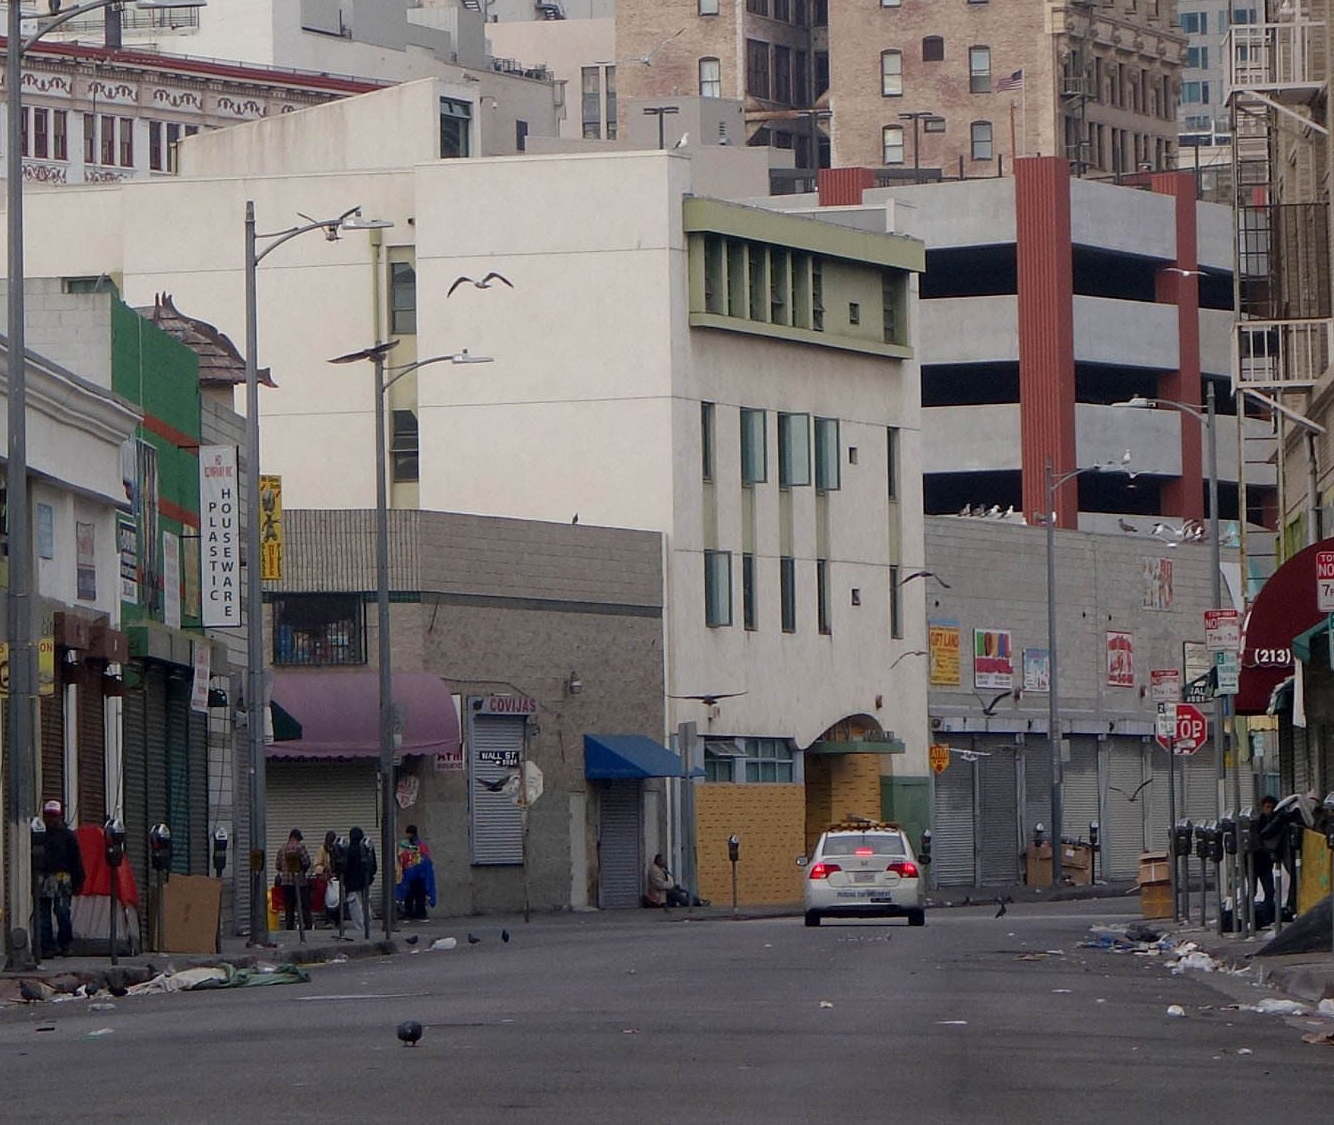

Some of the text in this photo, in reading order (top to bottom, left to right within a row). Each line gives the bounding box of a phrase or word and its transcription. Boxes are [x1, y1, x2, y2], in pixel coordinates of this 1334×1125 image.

[205, 466, 224, 477] COMPANY
[208, 502, 218, 601] PLASTIC
[221, 488, 234, 617] HOUSEWARE
[1318, 563, 1334, 576] NO
[1206, 618, 1217, 629] NO
[931, 632, 959, 647] GIFT LAND
[1218, 653, 1224, 664] 2
[1254, 648, 1291, 664] (213)
[490, 697, 536, 712] COVIJAS
[1158, 704, 1165, 713] 2
[931, 748, 947, 758] ATM
